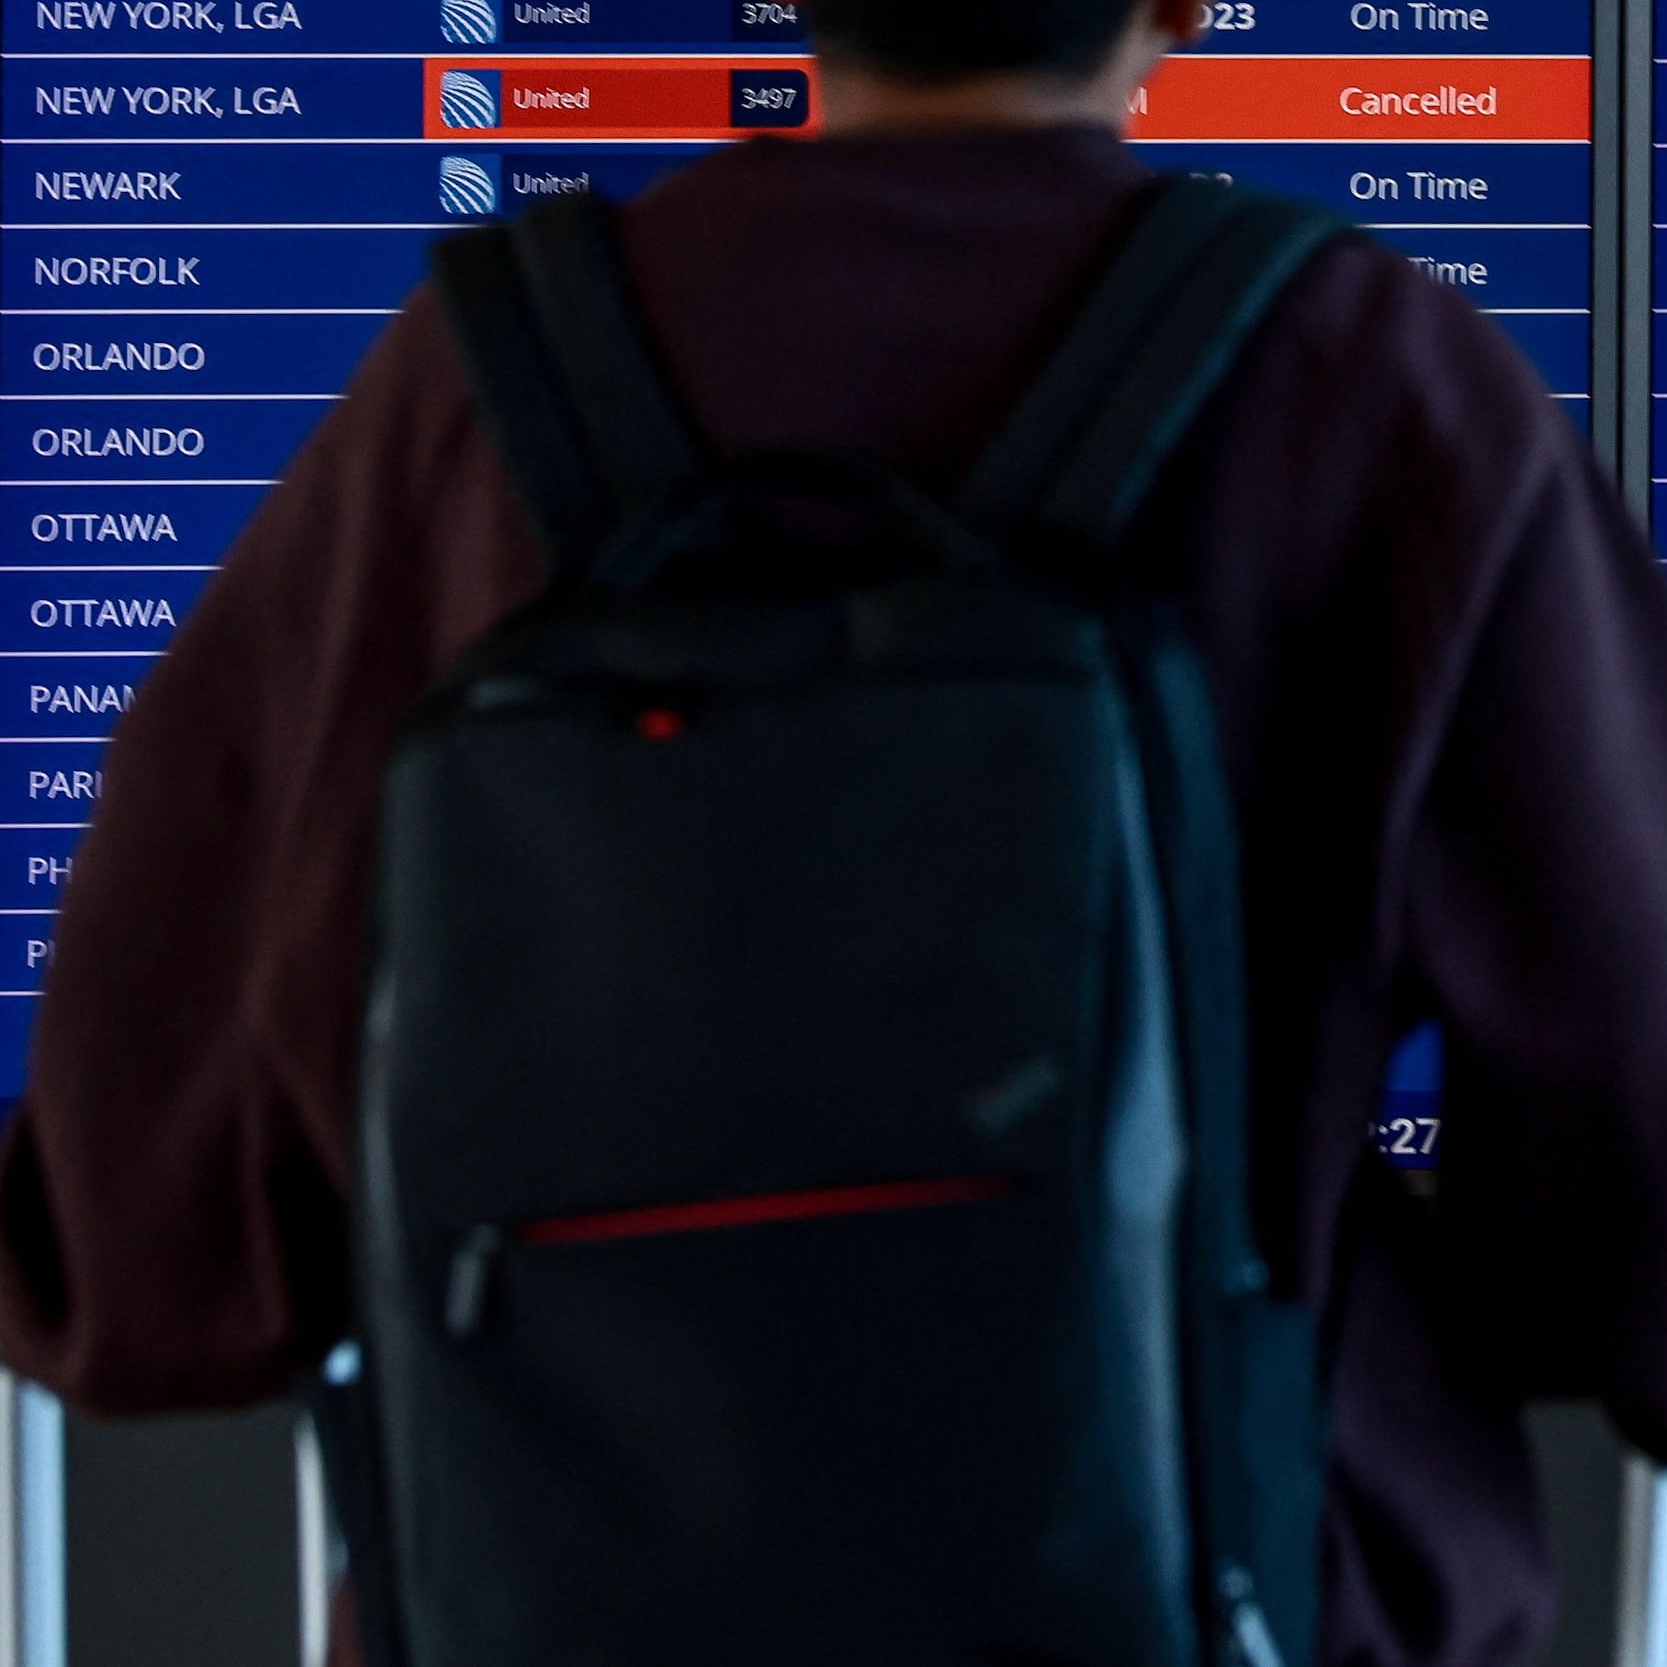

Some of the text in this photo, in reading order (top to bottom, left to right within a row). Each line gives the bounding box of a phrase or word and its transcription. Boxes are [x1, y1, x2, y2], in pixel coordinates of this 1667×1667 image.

[38, 87, 301, 118] NEW YORK, LGA
[514, 86, 589, 109] United
[1341, 87, 1497, 115] Cancelled
[32, 514, 178, 542] OTTAWA
